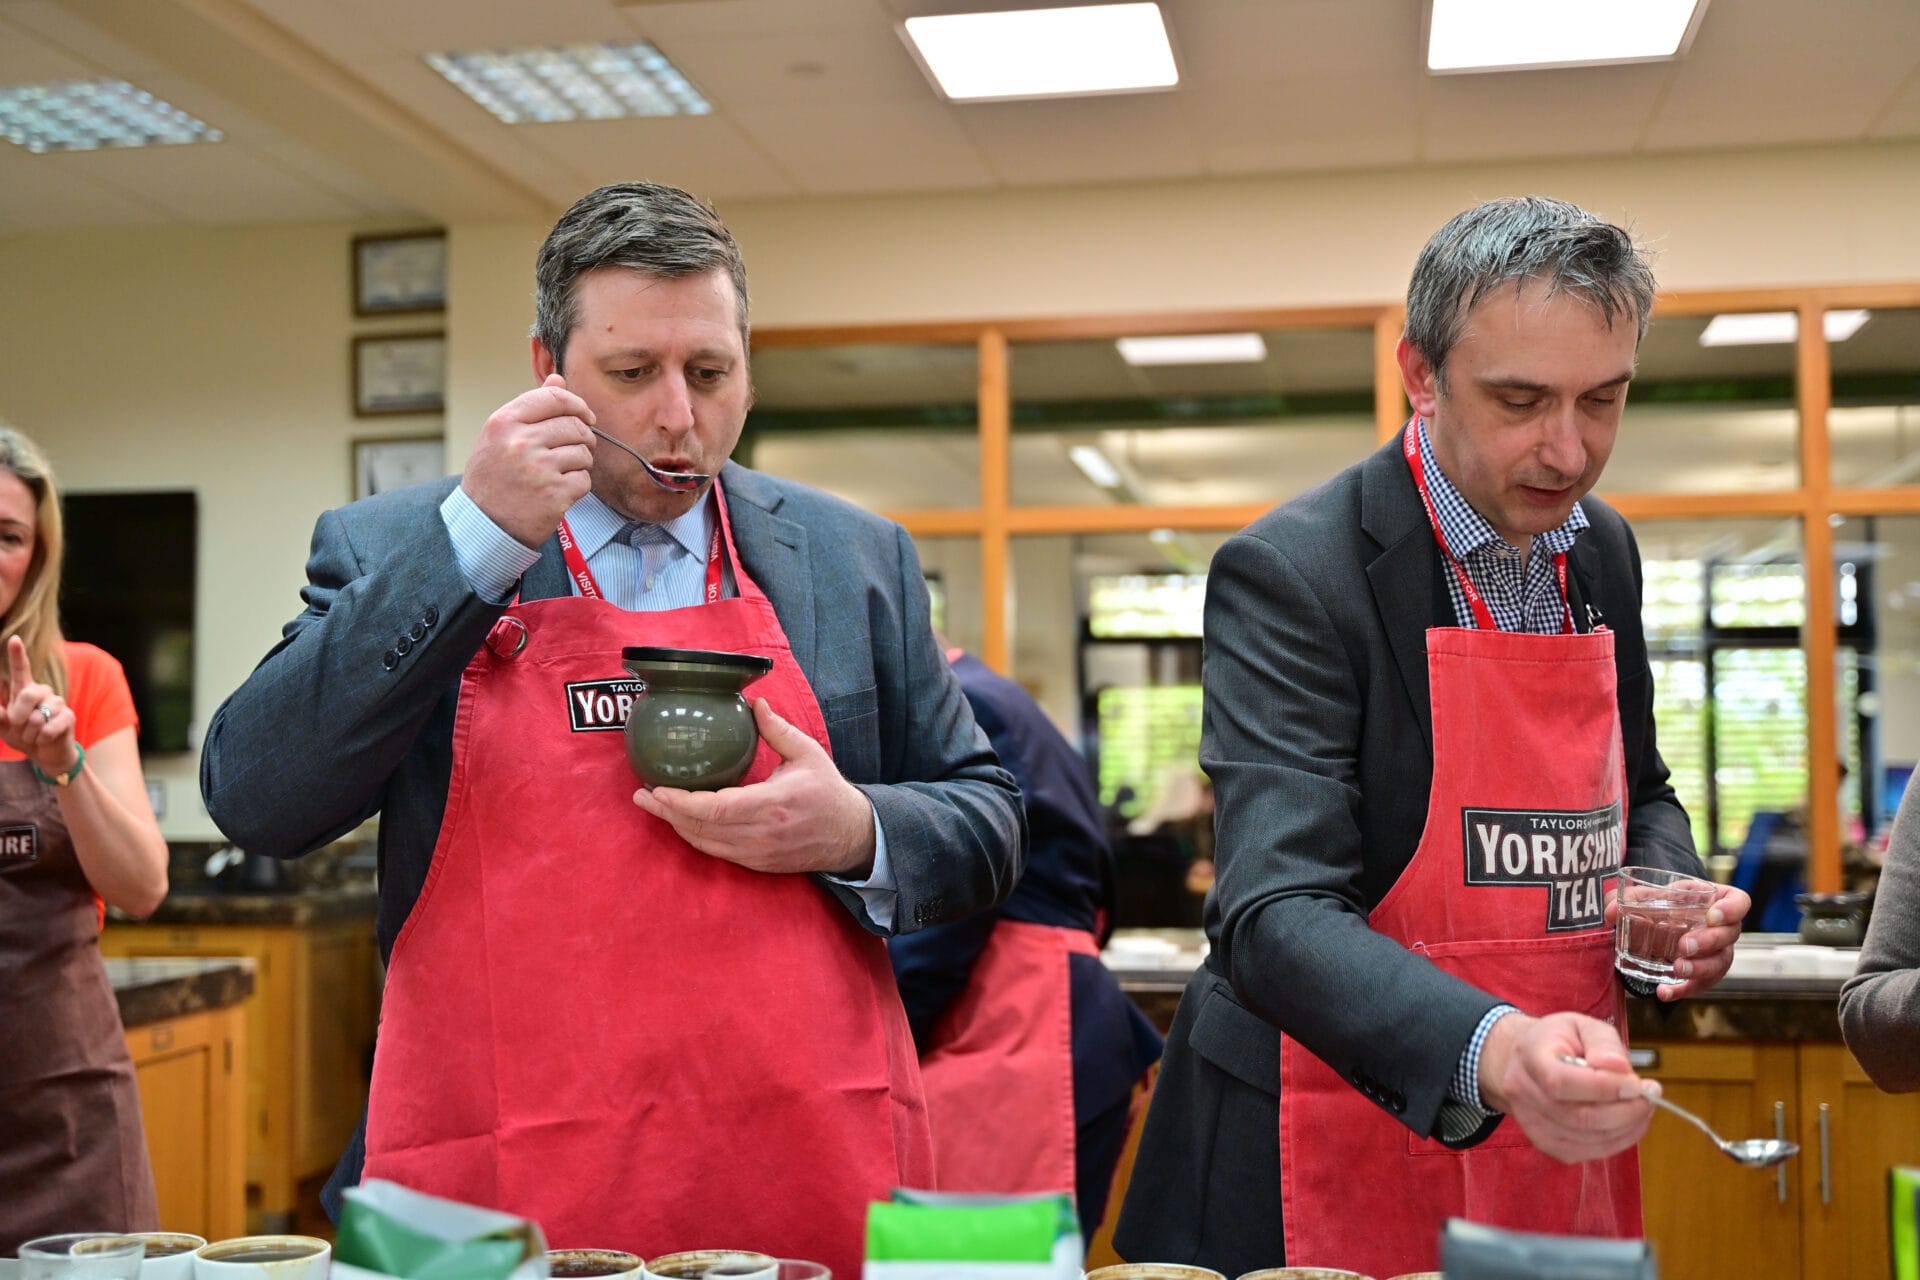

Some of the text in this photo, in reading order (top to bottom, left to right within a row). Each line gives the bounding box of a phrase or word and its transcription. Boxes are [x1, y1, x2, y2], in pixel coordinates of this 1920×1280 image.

[575, 690, 640, 723] YOR
[1530, 818, 1588, 830] TAYLORS
[1476, 821, 1621, 875] YORKSHIR
[1556, 877, 1599, 920] TEA
